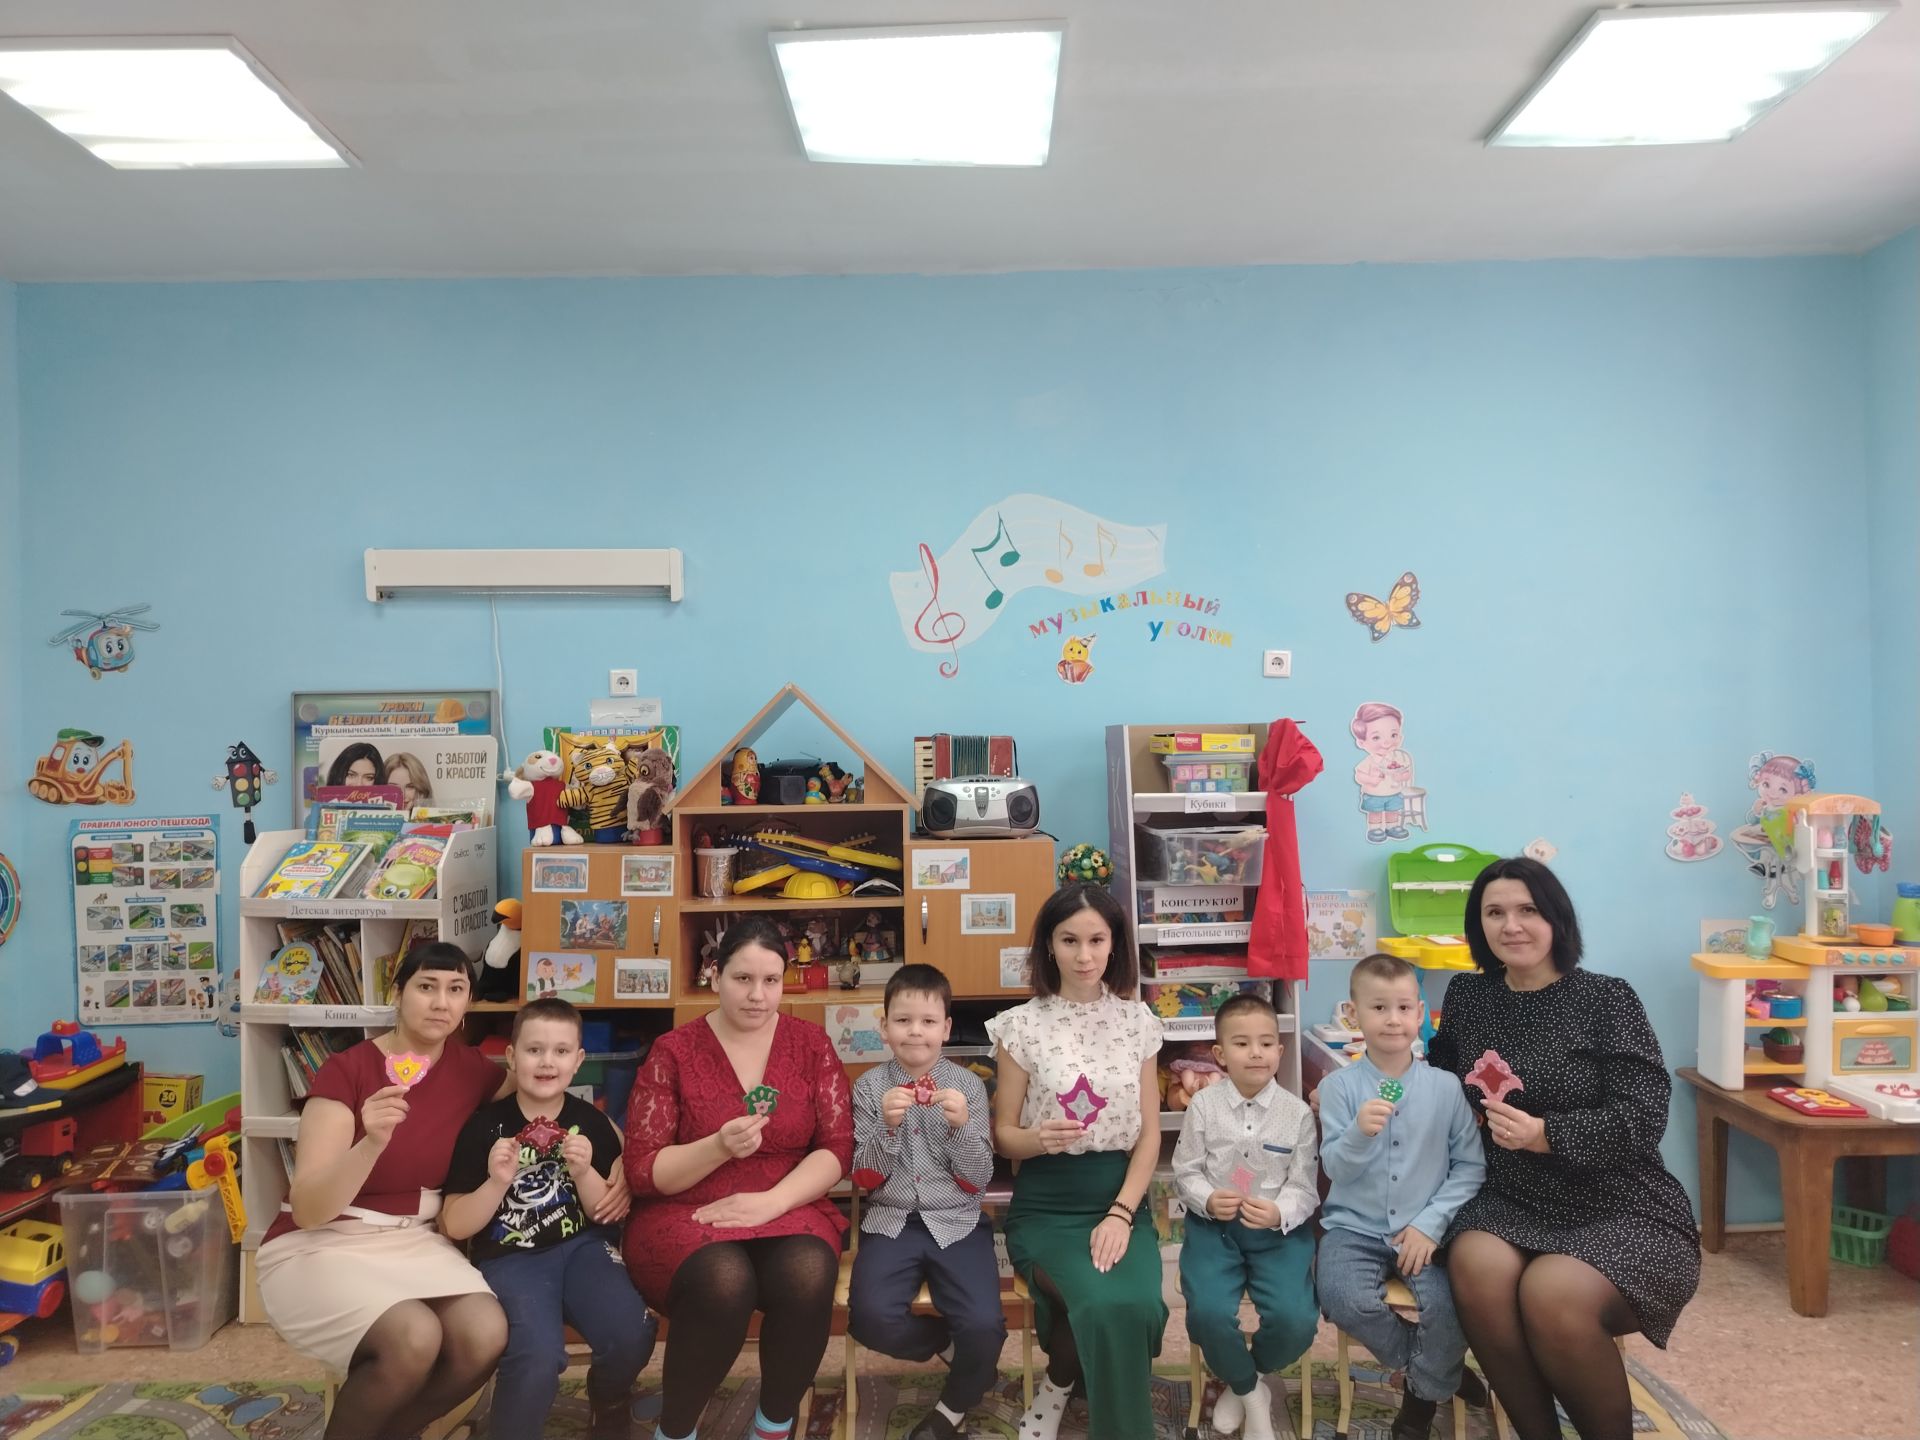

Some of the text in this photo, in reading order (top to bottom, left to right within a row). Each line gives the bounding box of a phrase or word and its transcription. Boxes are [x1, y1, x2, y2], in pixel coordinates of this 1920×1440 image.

[436, 750, 487, 765] С ЗАБОТОЙ
[436, 767, 486, 779] О КРАСОТЕ
[1190, 799, 1226, 811] Кубики
[80, 817, 211, 830] ПРАВИЛА ЮНОГО ПЕШЕХОДА
[453, 885, 489, 914] С ЗАБОТОЙ
[1161, 897, 1239, 908] КОНСТРУКТОР
[291, 904, 387, 918] Детская литература
[460, 909, 488, 935] КРАСОТЕ
[1163, 928, 1249, 939] Настольные игры
[325, 1009, 357, 1020] Книги
[161, 1091, 175, 1102] 30
